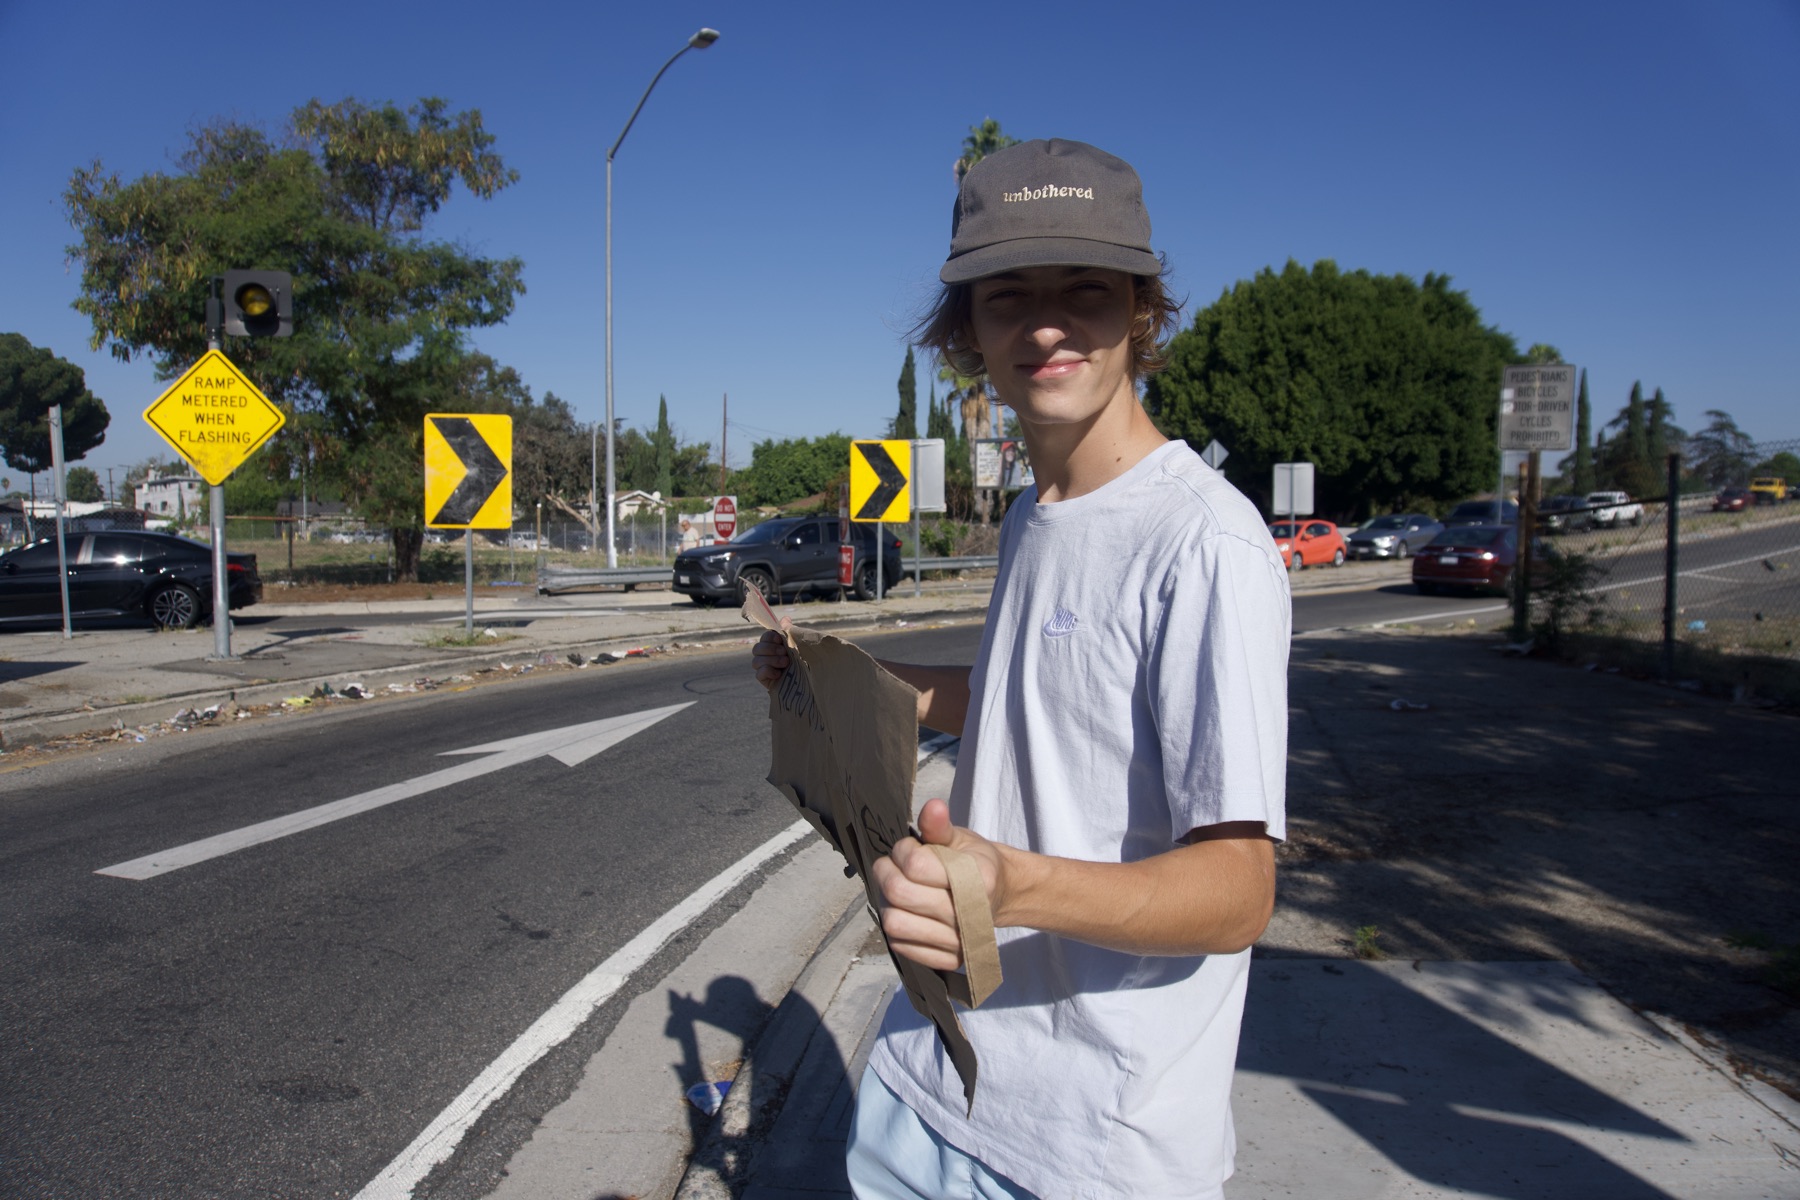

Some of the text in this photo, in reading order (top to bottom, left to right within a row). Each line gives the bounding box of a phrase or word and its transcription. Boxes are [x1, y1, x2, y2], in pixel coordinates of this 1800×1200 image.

[1002, 184, 1095, 202] unbothered
[194, 376, 236, 389] RAMP
[1517, 386, 1559, 397] BICYCLES
[182, 394, 248, 408] METERED
[1513, 401, 1570, 412] OTOR-DRIVEN
[194, 413, 236, 425] WHEN
[1519, 415, 1553, 427] CYCLES
[179, 430, 251, 444] FLASHING
[1510, 430, 1560, 442] PROHIBITED
[716, 504, 733, 512] DO NOT
[717, 523, 732, 531] ENTER
